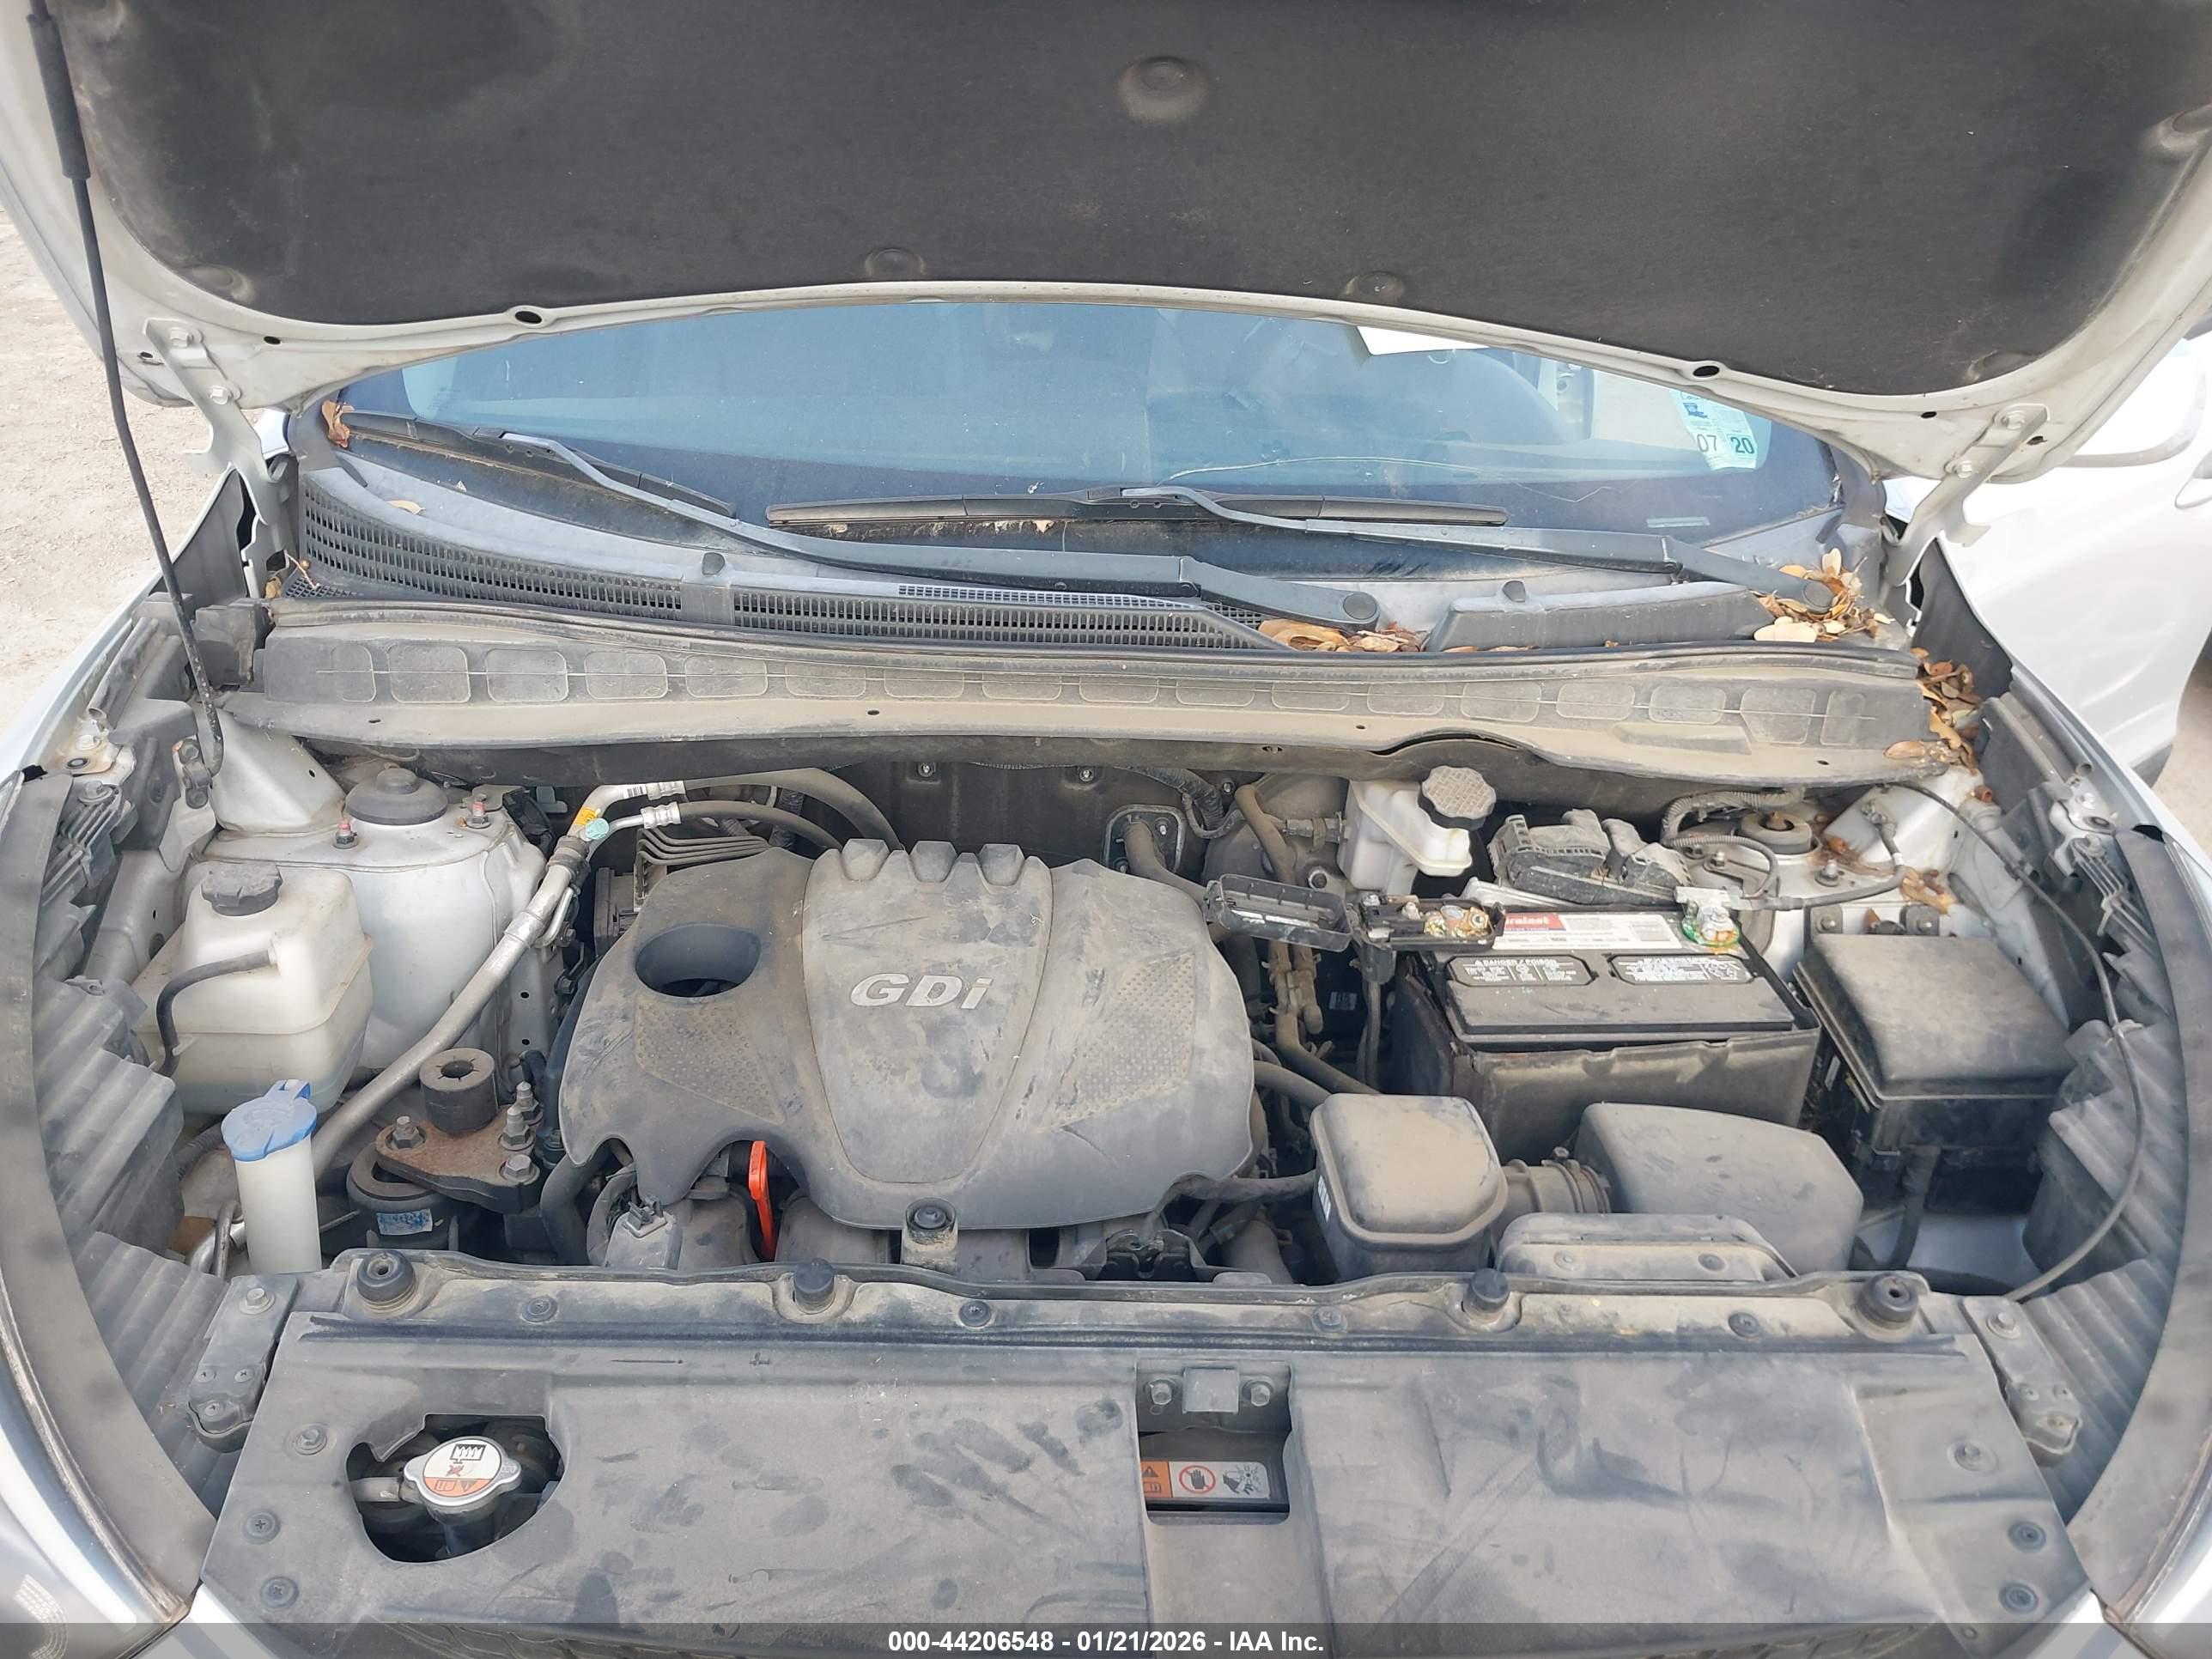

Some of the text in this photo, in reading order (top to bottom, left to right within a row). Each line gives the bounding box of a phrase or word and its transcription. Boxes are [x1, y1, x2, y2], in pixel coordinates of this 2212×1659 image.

[1696, 434, 1755, 454] 07 20
[850, 972, 994, 1010] GDi
